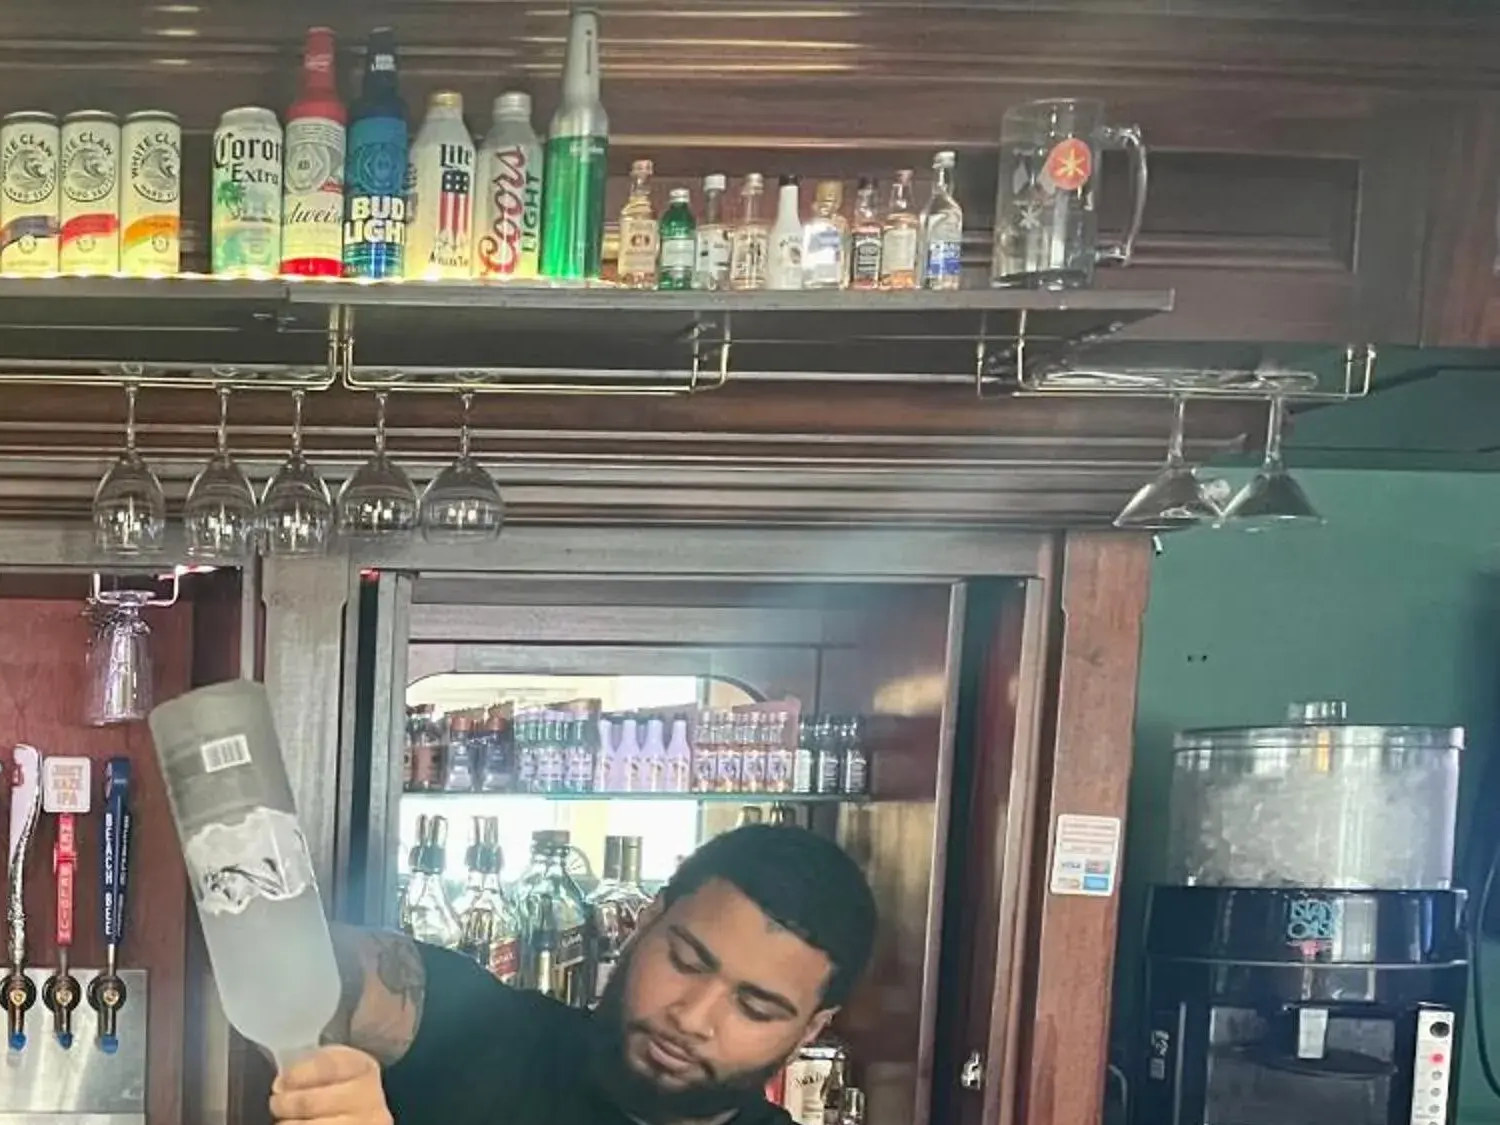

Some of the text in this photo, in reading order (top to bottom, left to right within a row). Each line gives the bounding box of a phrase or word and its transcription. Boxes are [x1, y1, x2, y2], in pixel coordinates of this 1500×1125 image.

[440, 143, 473, 169] Lite
[352, 196, 405, 220] BUD
[478, 145, 526, 276] Coors
[521, 171, 541, 252] LIGHT
[343, 220, 405, 244] LIGH
